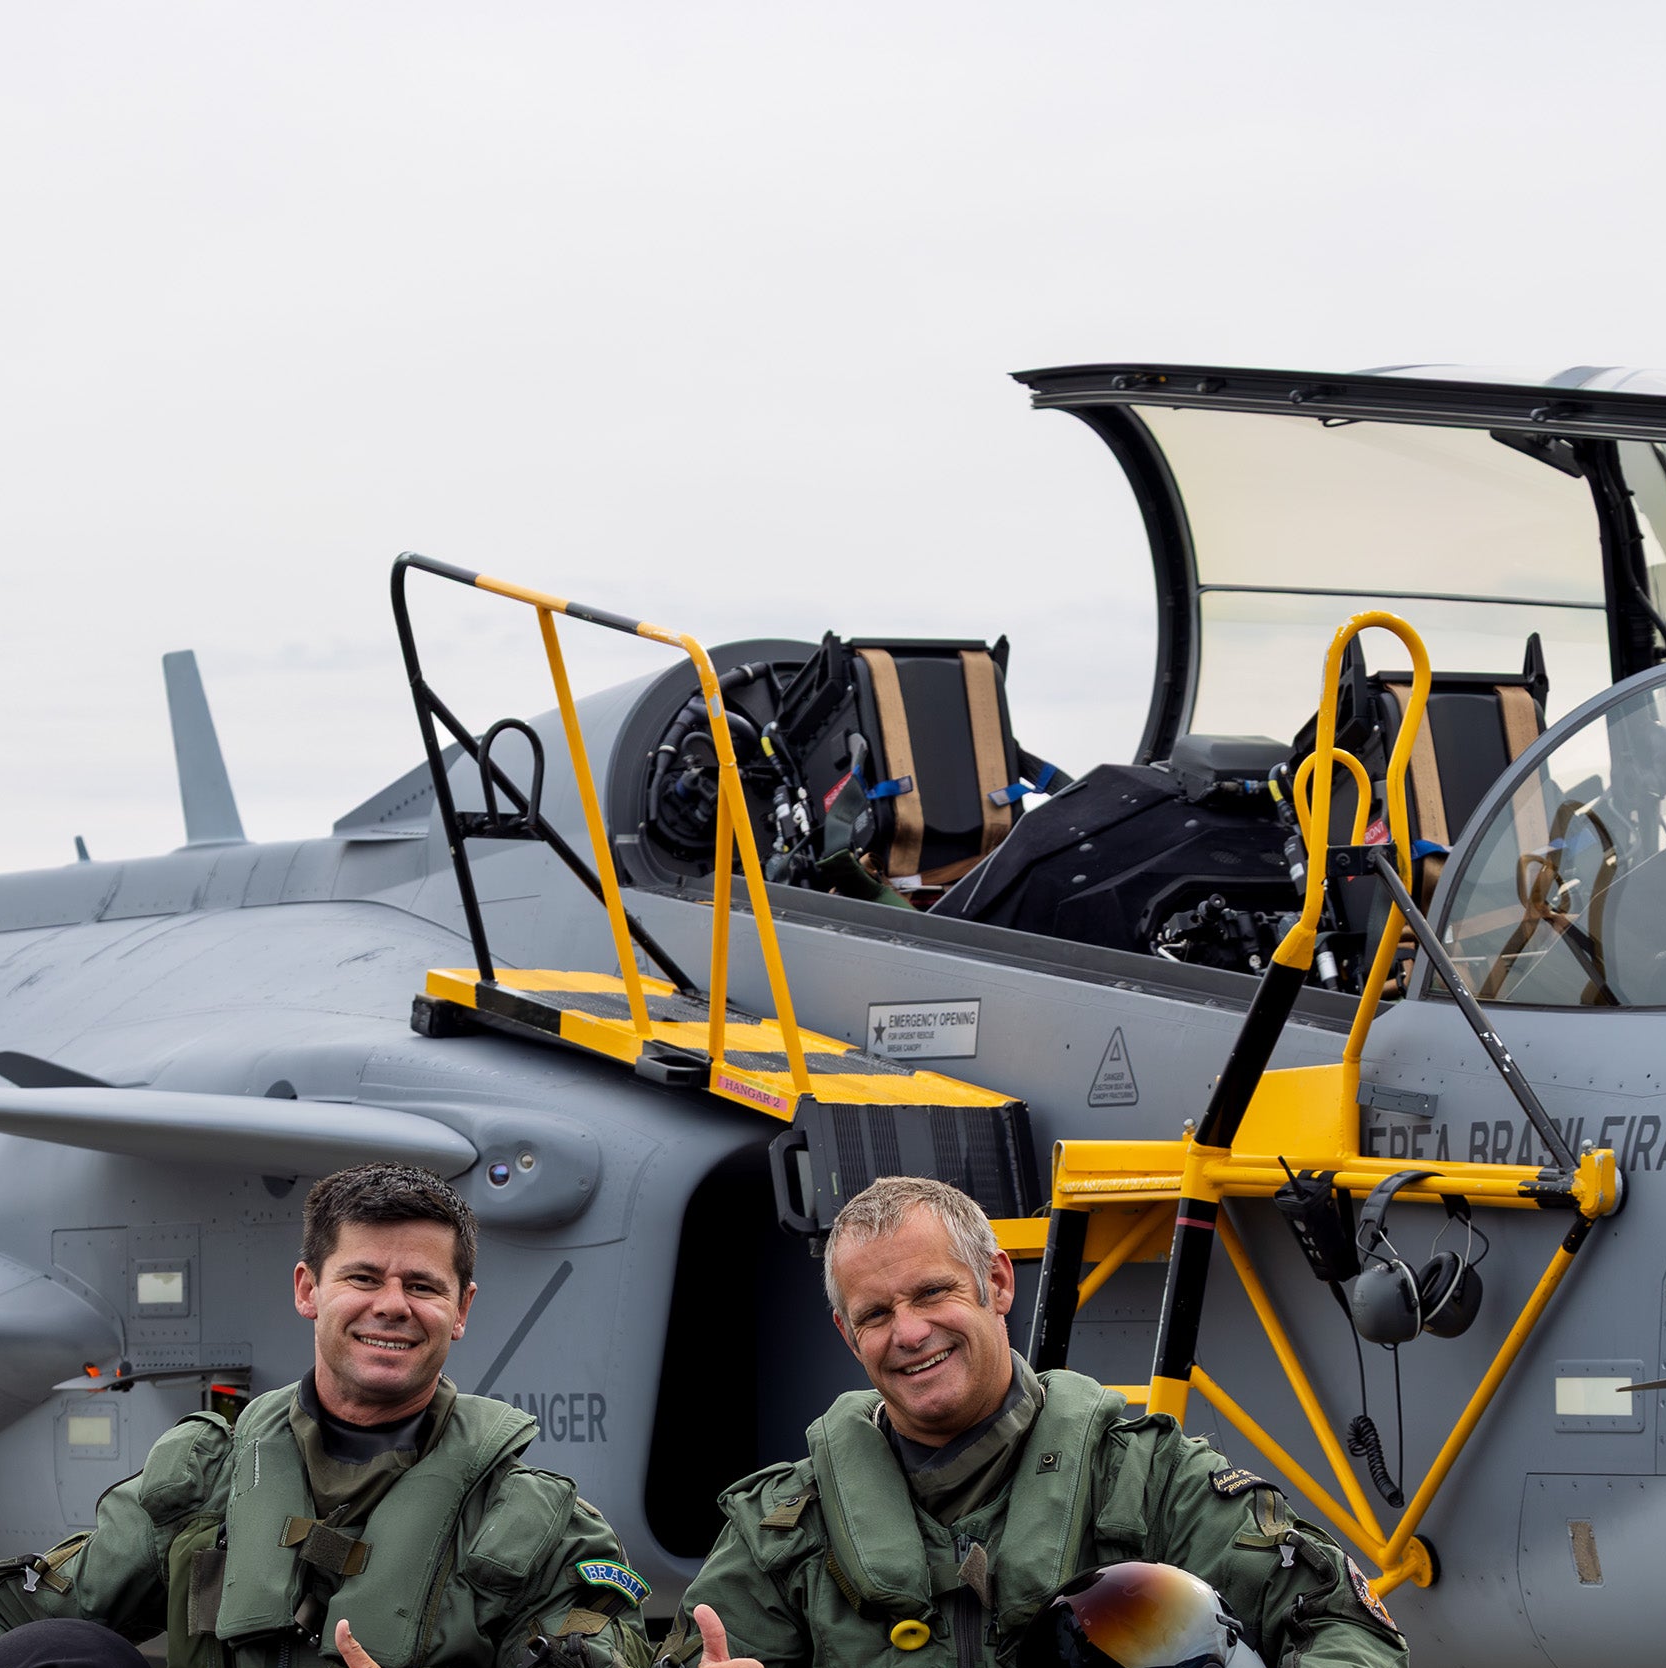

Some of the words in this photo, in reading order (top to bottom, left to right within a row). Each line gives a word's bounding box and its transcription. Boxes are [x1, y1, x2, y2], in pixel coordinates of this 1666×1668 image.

[888, 1012, 939, 1029] EMERGENCY
[939, 1010, 977, 1026] OPENING
[725, 1078, 771, 1105] HANGAR
[773, 1097, 780, 1108] 2
[586, 1565, 642, 1600] BRASIL
